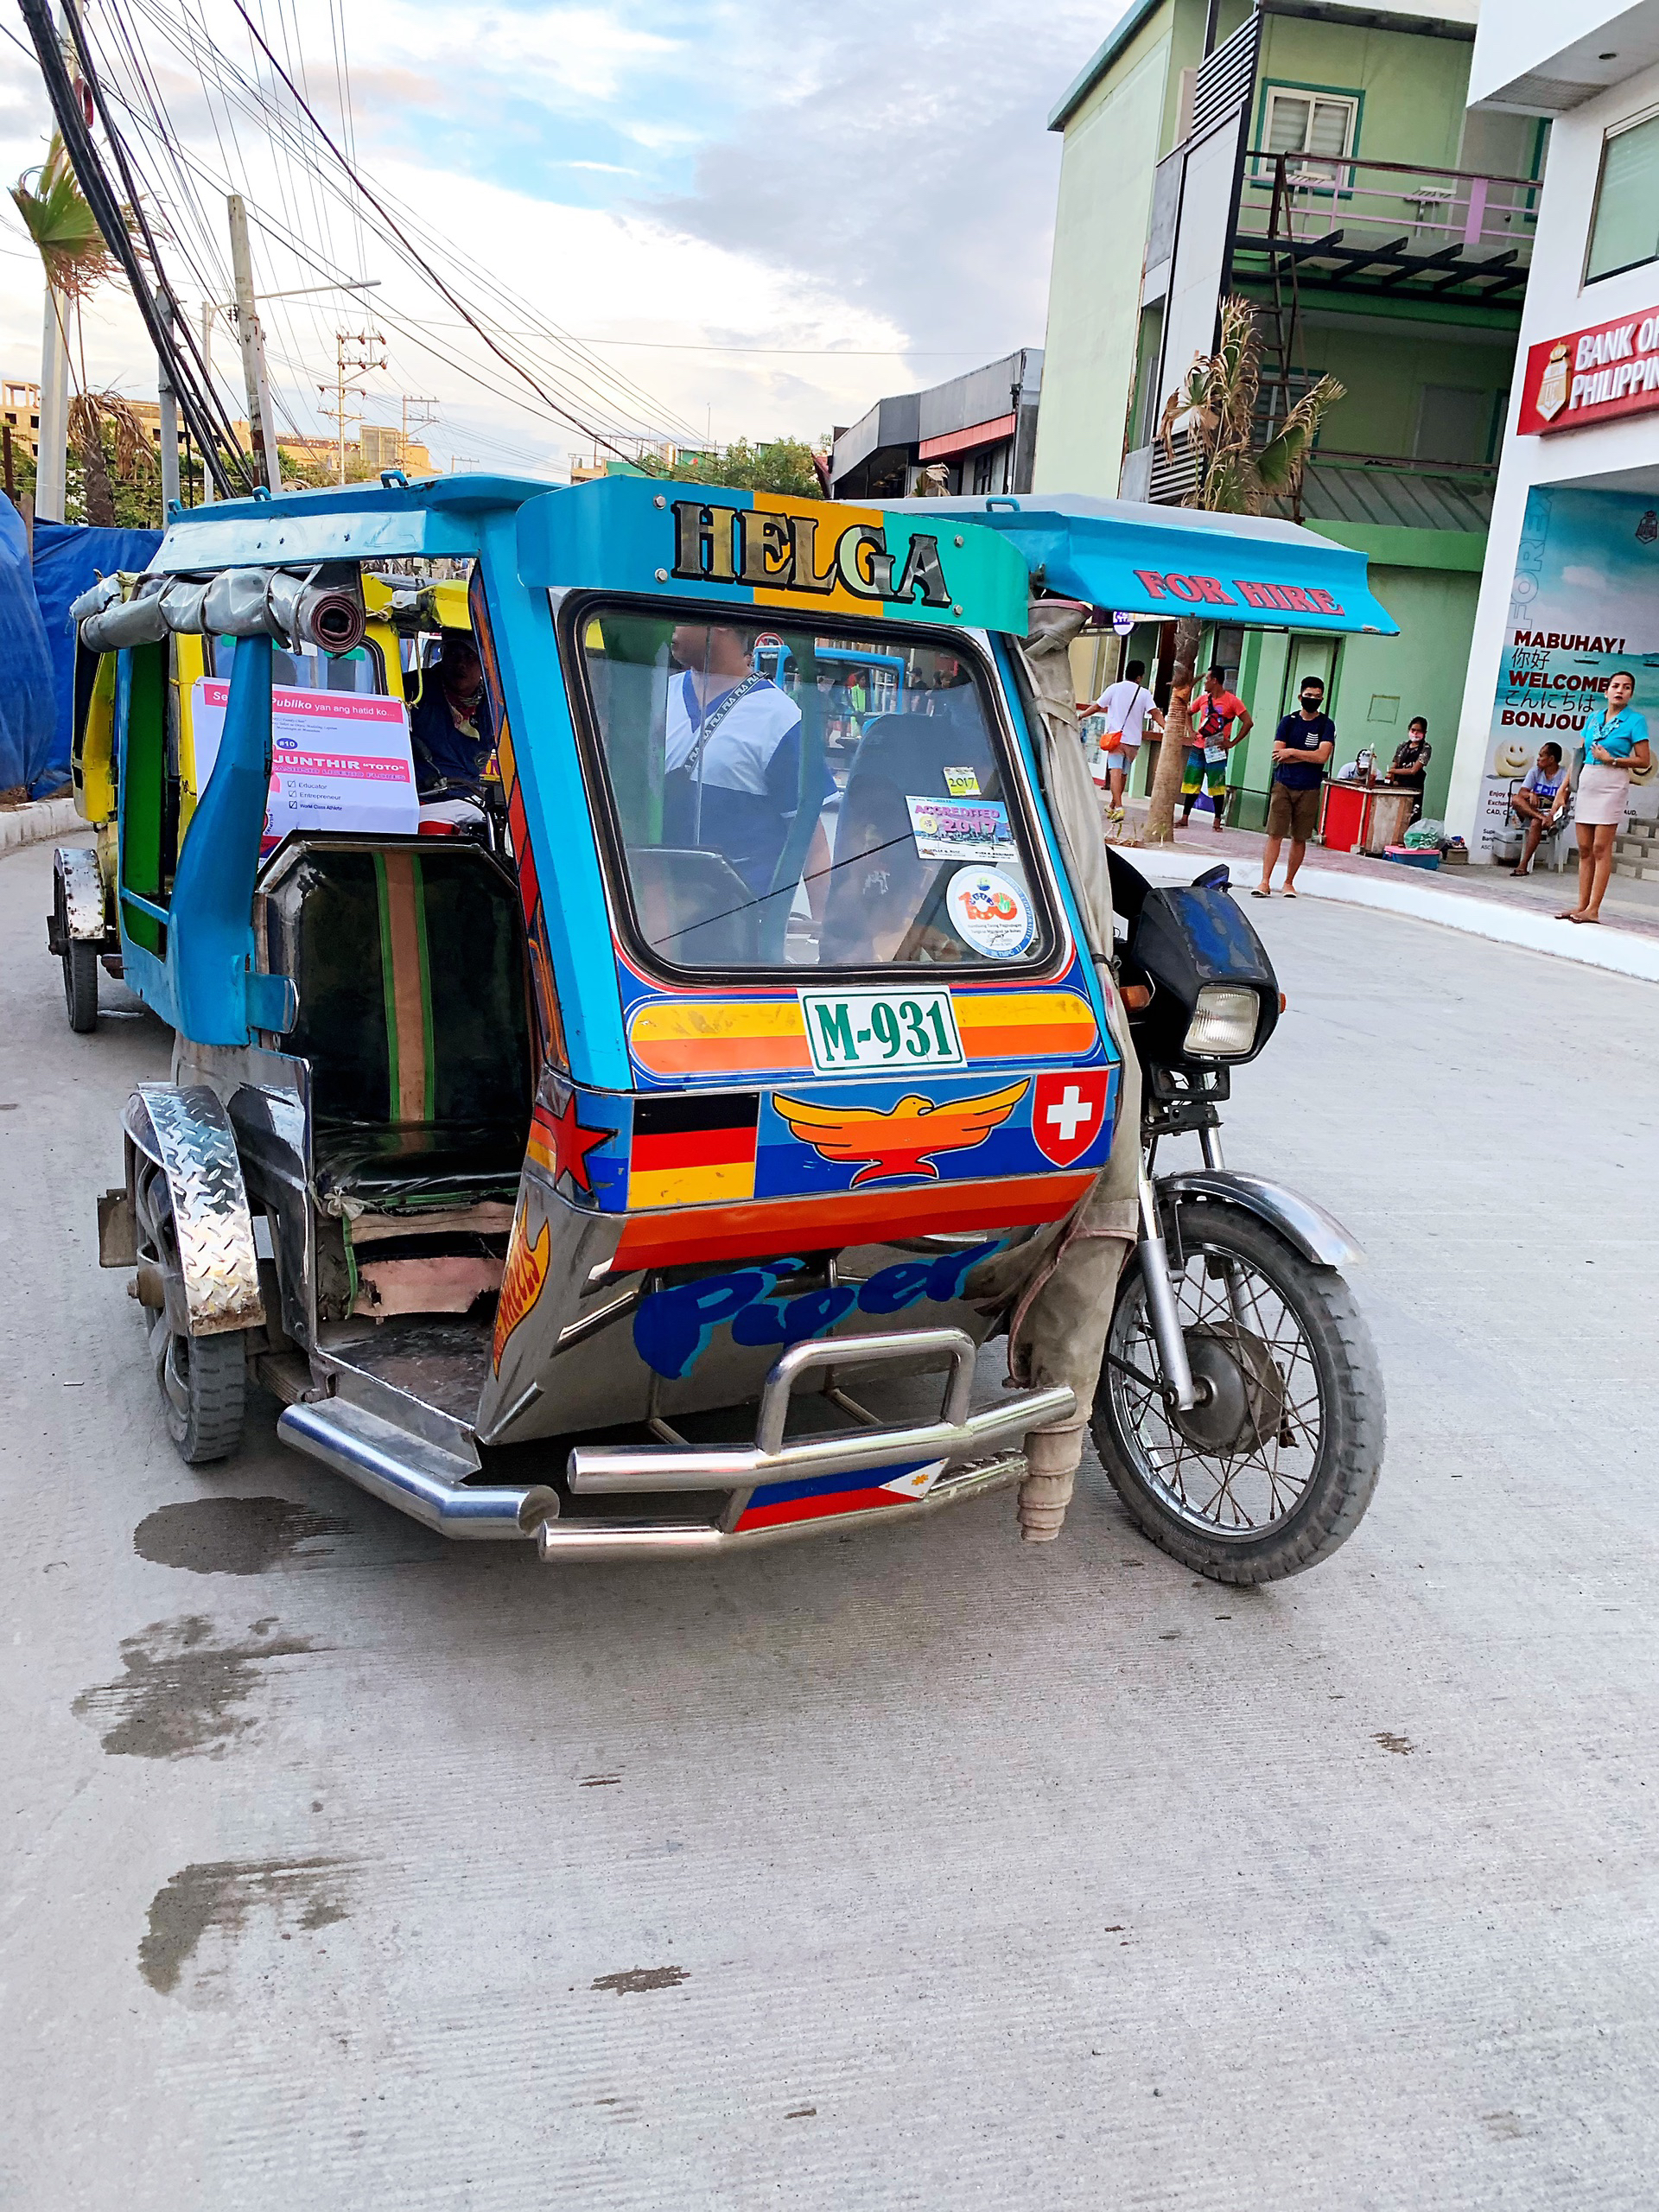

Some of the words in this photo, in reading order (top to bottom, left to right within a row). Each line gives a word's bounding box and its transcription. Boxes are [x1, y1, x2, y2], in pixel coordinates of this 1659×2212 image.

[1575, 322, 1637, 372] BANK
[671, 500, 952, 609] HELGA
[1133, 569, 1238, 607] FOR
[1231, 580, 1345, 616] HIRE
[1514, 630, 1625, 655] MABUHAY!
[1511, 648, 1551, 670] 你好
[1509, 670, 1610, 693] WELCOME
[334, 706, 351, 715] ang
[353, 706, 373, 715] hatid
[1505, 690, 1596, 713] こんにちは
[1501, 709, 1589, 731] BONJOU
[273, 754, 360, 770] JUNTHIR
[948, 778, 975, 790] 2017
[300, 791, 341, 801] Entrepreneur
[915, 804, 1001, 818] ACCREDITED
[942, 818, 996, 834] 2017
[815, 1001, 952, 1061] M-931
